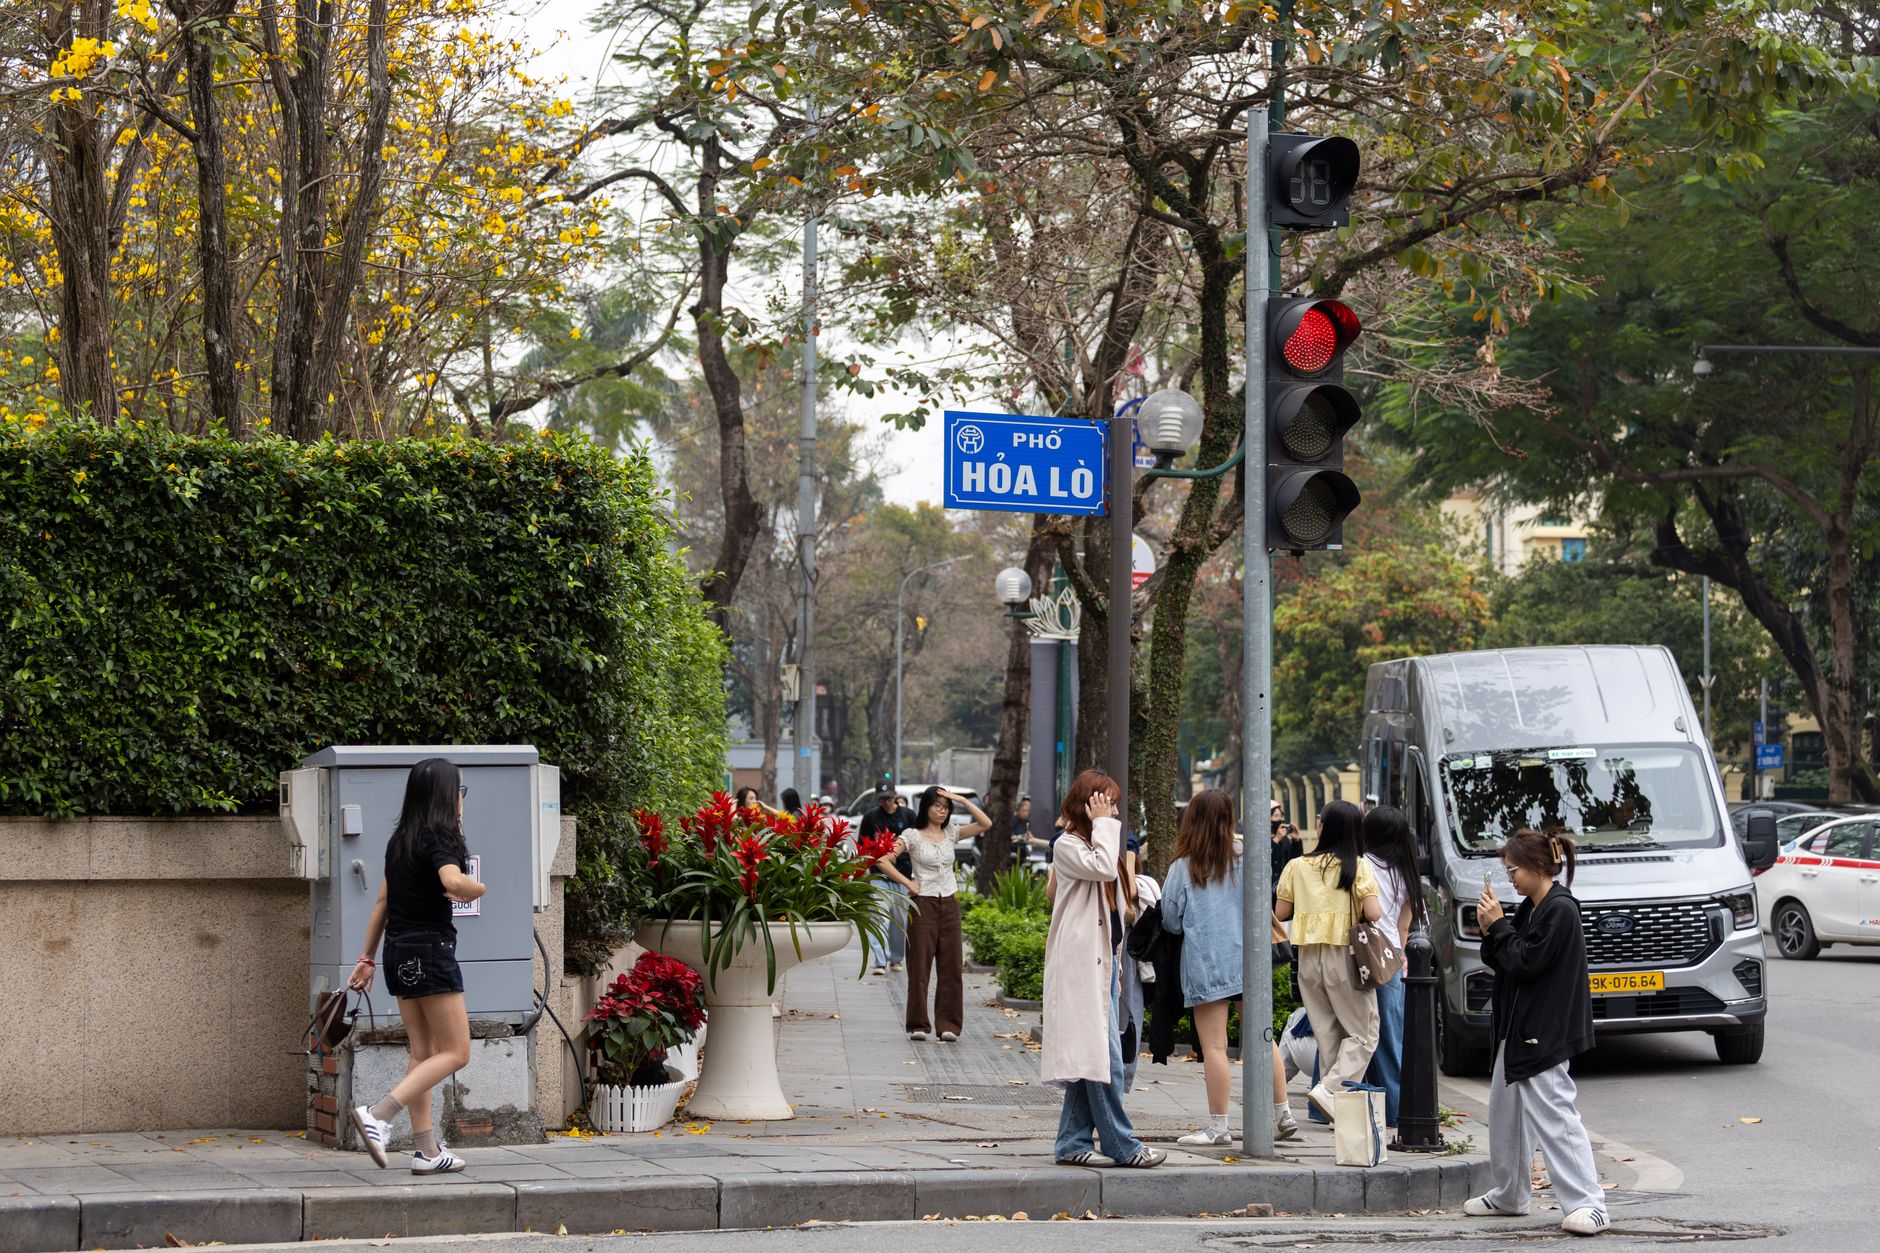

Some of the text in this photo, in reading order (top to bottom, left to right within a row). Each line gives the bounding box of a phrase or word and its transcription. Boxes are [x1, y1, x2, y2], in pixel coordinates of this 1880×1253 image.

[1012, 428, 1063, 450] PHỐ
[962, 452, 1094, 499] HỎA LÒ
[1605, 918, 1626, 929] Ford
[1589, 975, 1657, 990] 9K-076.64
